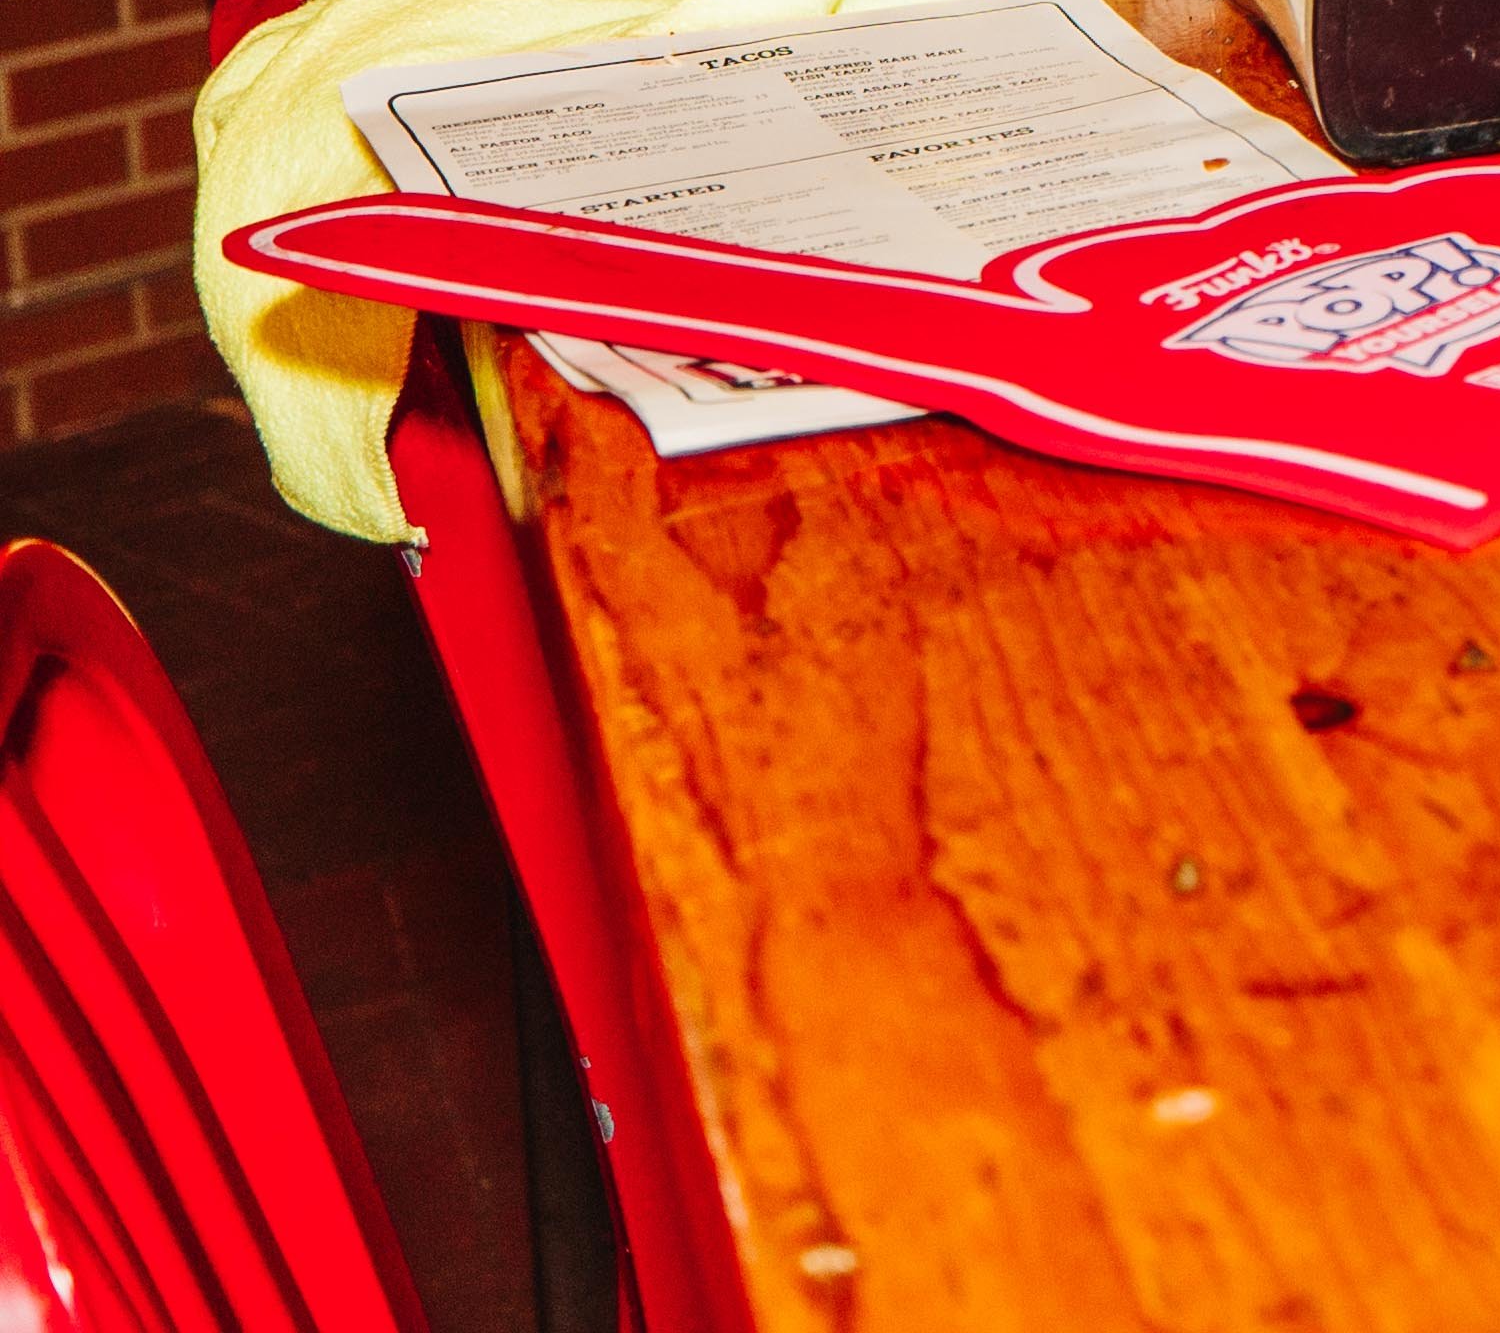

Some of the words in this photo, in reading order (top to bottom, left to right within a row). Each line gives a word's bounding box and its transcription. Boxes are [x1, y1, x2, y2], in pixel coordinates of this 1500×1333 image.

[700, 46, 794, 70] TACOS
[784, 60, 871, 76] BLACKENED
[803, 89, 855, 101] CARNE
[432, 108, 553, 130] CHEESEBURGER
[563, 102, 604, 112] TACO
[480, 136, 541, 149] PASTOR
[549, 129, 591, 140] TACO
[869, 126, 1034, 163] FAVORITES
[465, 162, 537, 177] CHICKEN
[545, 153, 598, 165] TINGA
[606, 146, 648, 156] TACO
[580, 183, 726, 214] STARTED
[1178, 236, 1500, 354] POP!
